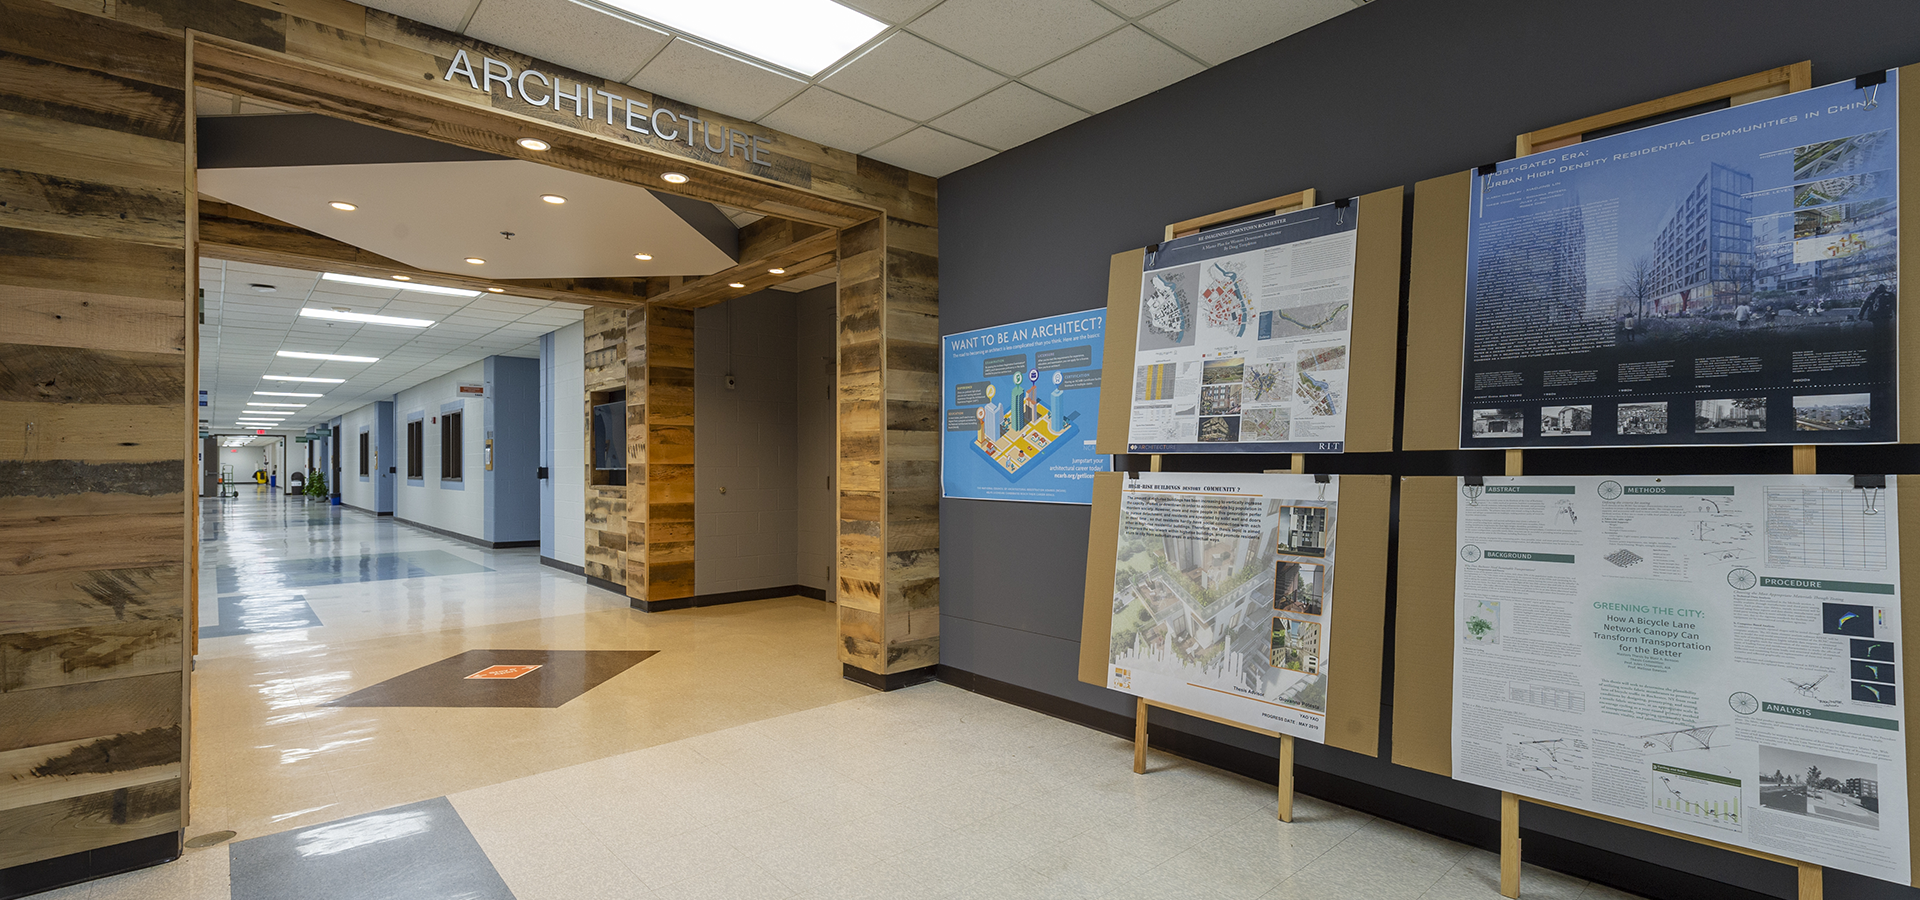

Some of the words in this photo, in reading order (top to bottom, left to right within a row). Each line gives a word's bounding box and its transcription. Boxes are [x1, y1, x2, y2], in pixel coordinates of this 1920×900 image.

[443, 49, 772, 167] ARCHITECTURE
[1528, 170, 1554, 180] HIGH
[1560, 158, 1607, 172] DENSITY
[1613, 139, 1695, 161] RESIDENTIAL
[1701, 115, 1798, 142] COMMUNITIES
[1805, 111, 1819, 119] IN
[1562, 150, 1589, 161] ERA:
[1258, 218, 1286, 228] ROCHESTER
[951, 337, 978, 351] WANT
[981, 335, 994, 346] TO
[998, 332, 1009, 344] BE
[1012, 329, 1027, 342] AN
[1031, 317, 1102, 338] ARCHITECT?
[1765, 578, 1822, 588] PROCEDURE
[1593, 602, 1650, 613] GREENING
[1653, 606, 1674, 616] THE
[1677, 609, 1705, 618] CITY:
[1607, 614, 1626, 623] How
[1638, 618, 1669, 628] Bicycle
[1673, 621, 1695, 629] Lane
[1604, 624, 1641, 634] Network
[1644, 628, 1678, 639] Canopy
[1593, 632, 1638, 643] Transform
[1640, 636, 1712, 651] Transportation
[1634, 646, 1650, 654] the
[1653, 648, 1682, 658] Better
[1262, 713, 1283, 721] PROGRESS
[1766, 704, 1812, 716] ANALYSIS
